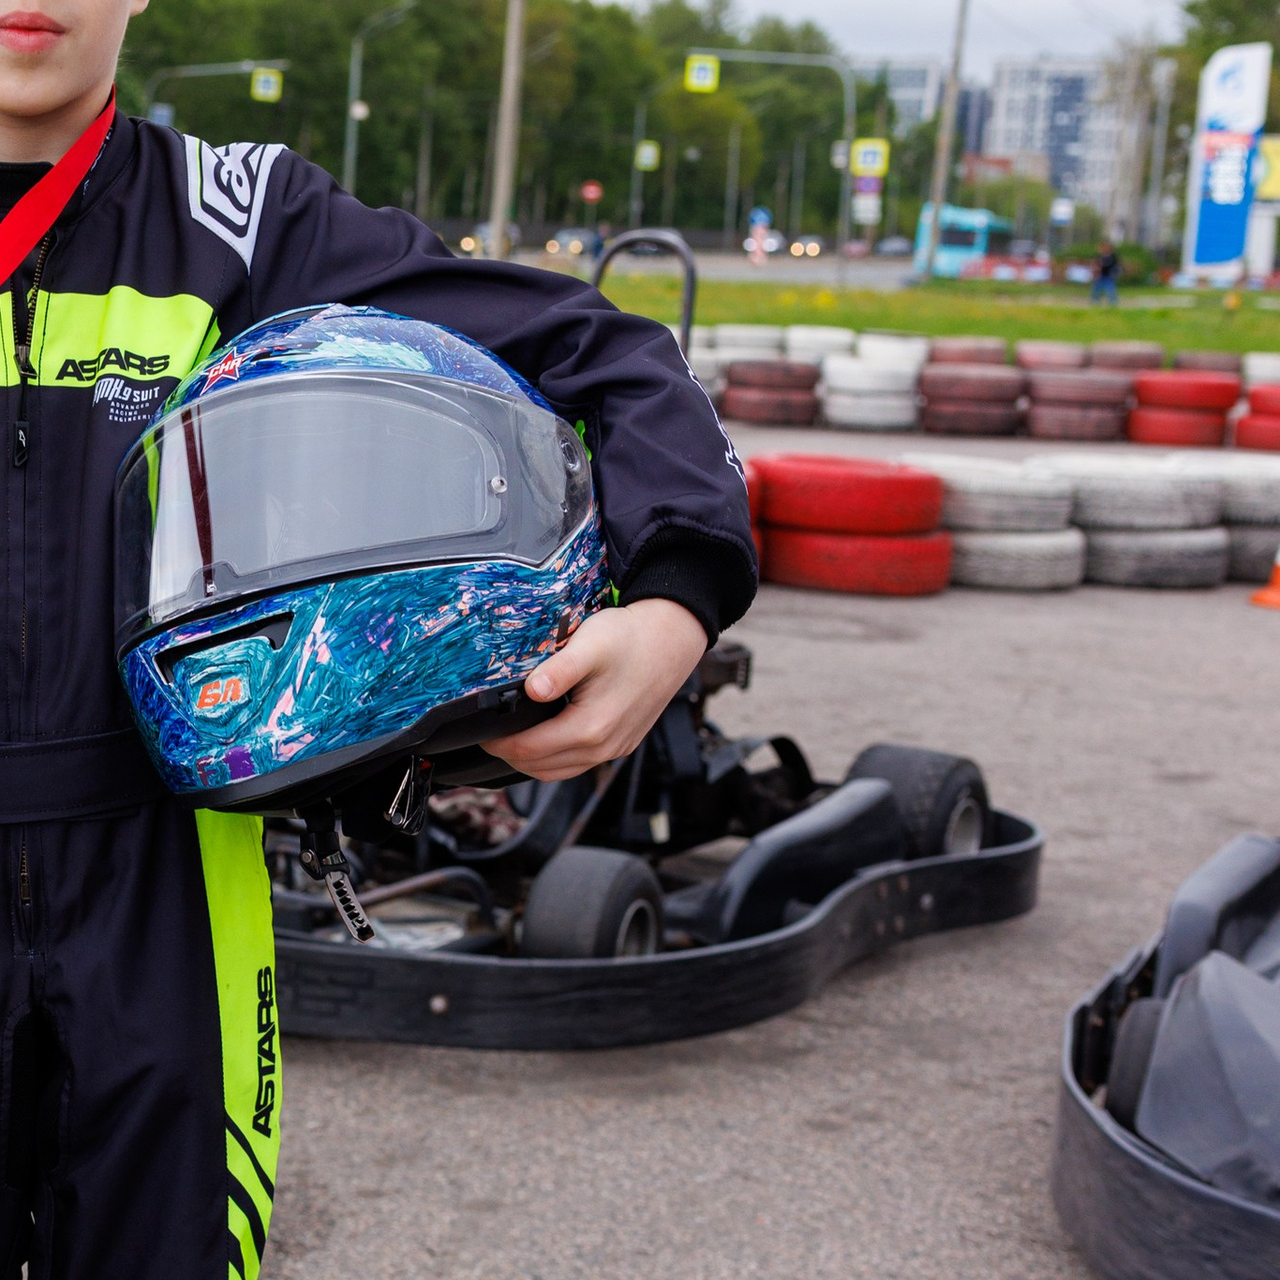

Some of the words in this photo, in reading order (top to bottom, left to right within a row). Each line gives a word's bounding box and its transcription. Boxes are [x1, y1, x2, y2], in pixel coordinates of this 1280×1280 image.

[132, 387, 160, 402] SUIT
[110, 401, 150, 410] ADVANCED
[109, 407, 138, 417] RACING
[108, 414, 151, 422] ENGINEERI
[252, 965, 277, 1139] ASTARS
